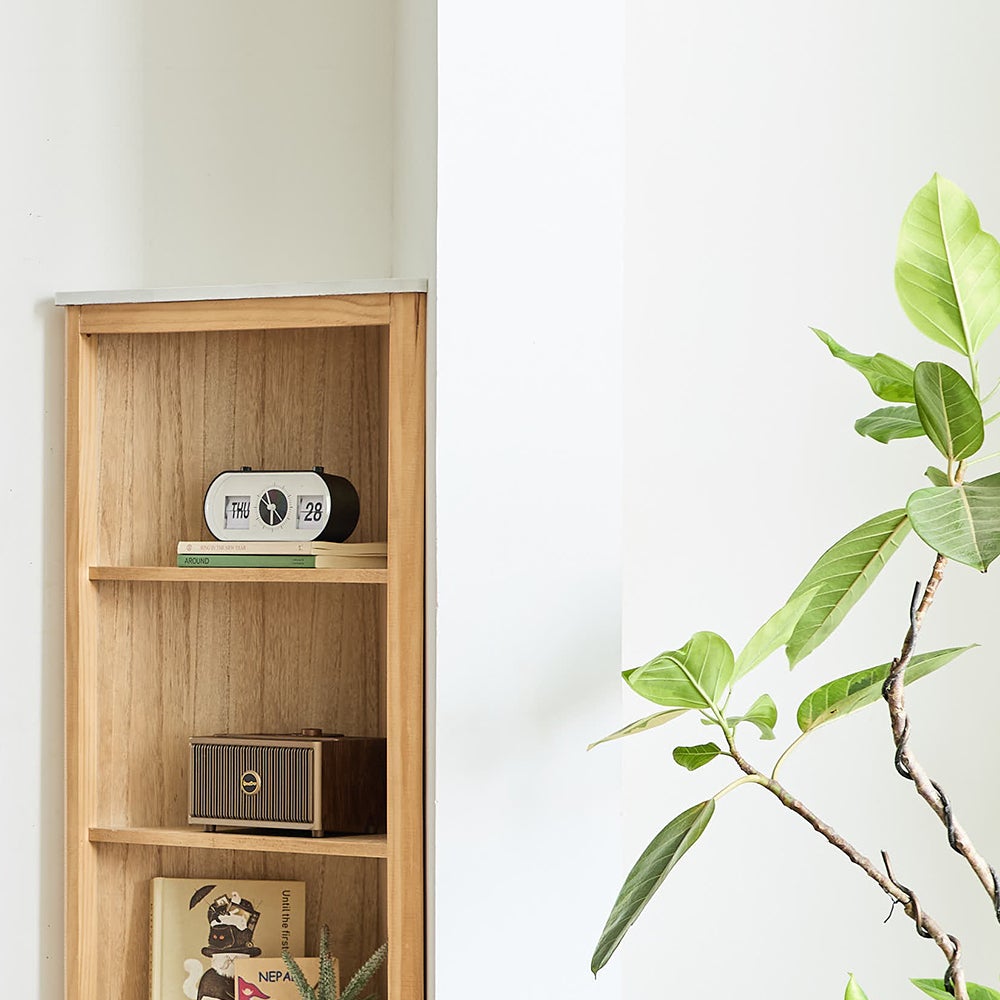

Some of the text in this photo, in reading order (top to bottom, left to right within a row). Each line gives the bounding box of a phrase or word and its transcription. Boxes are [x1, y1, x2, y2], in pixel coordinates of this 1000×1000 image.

[231, 502, 250, 519] THU
[304, 502, 322, 521] 28
[281, 890, 291, 950] Until the first
